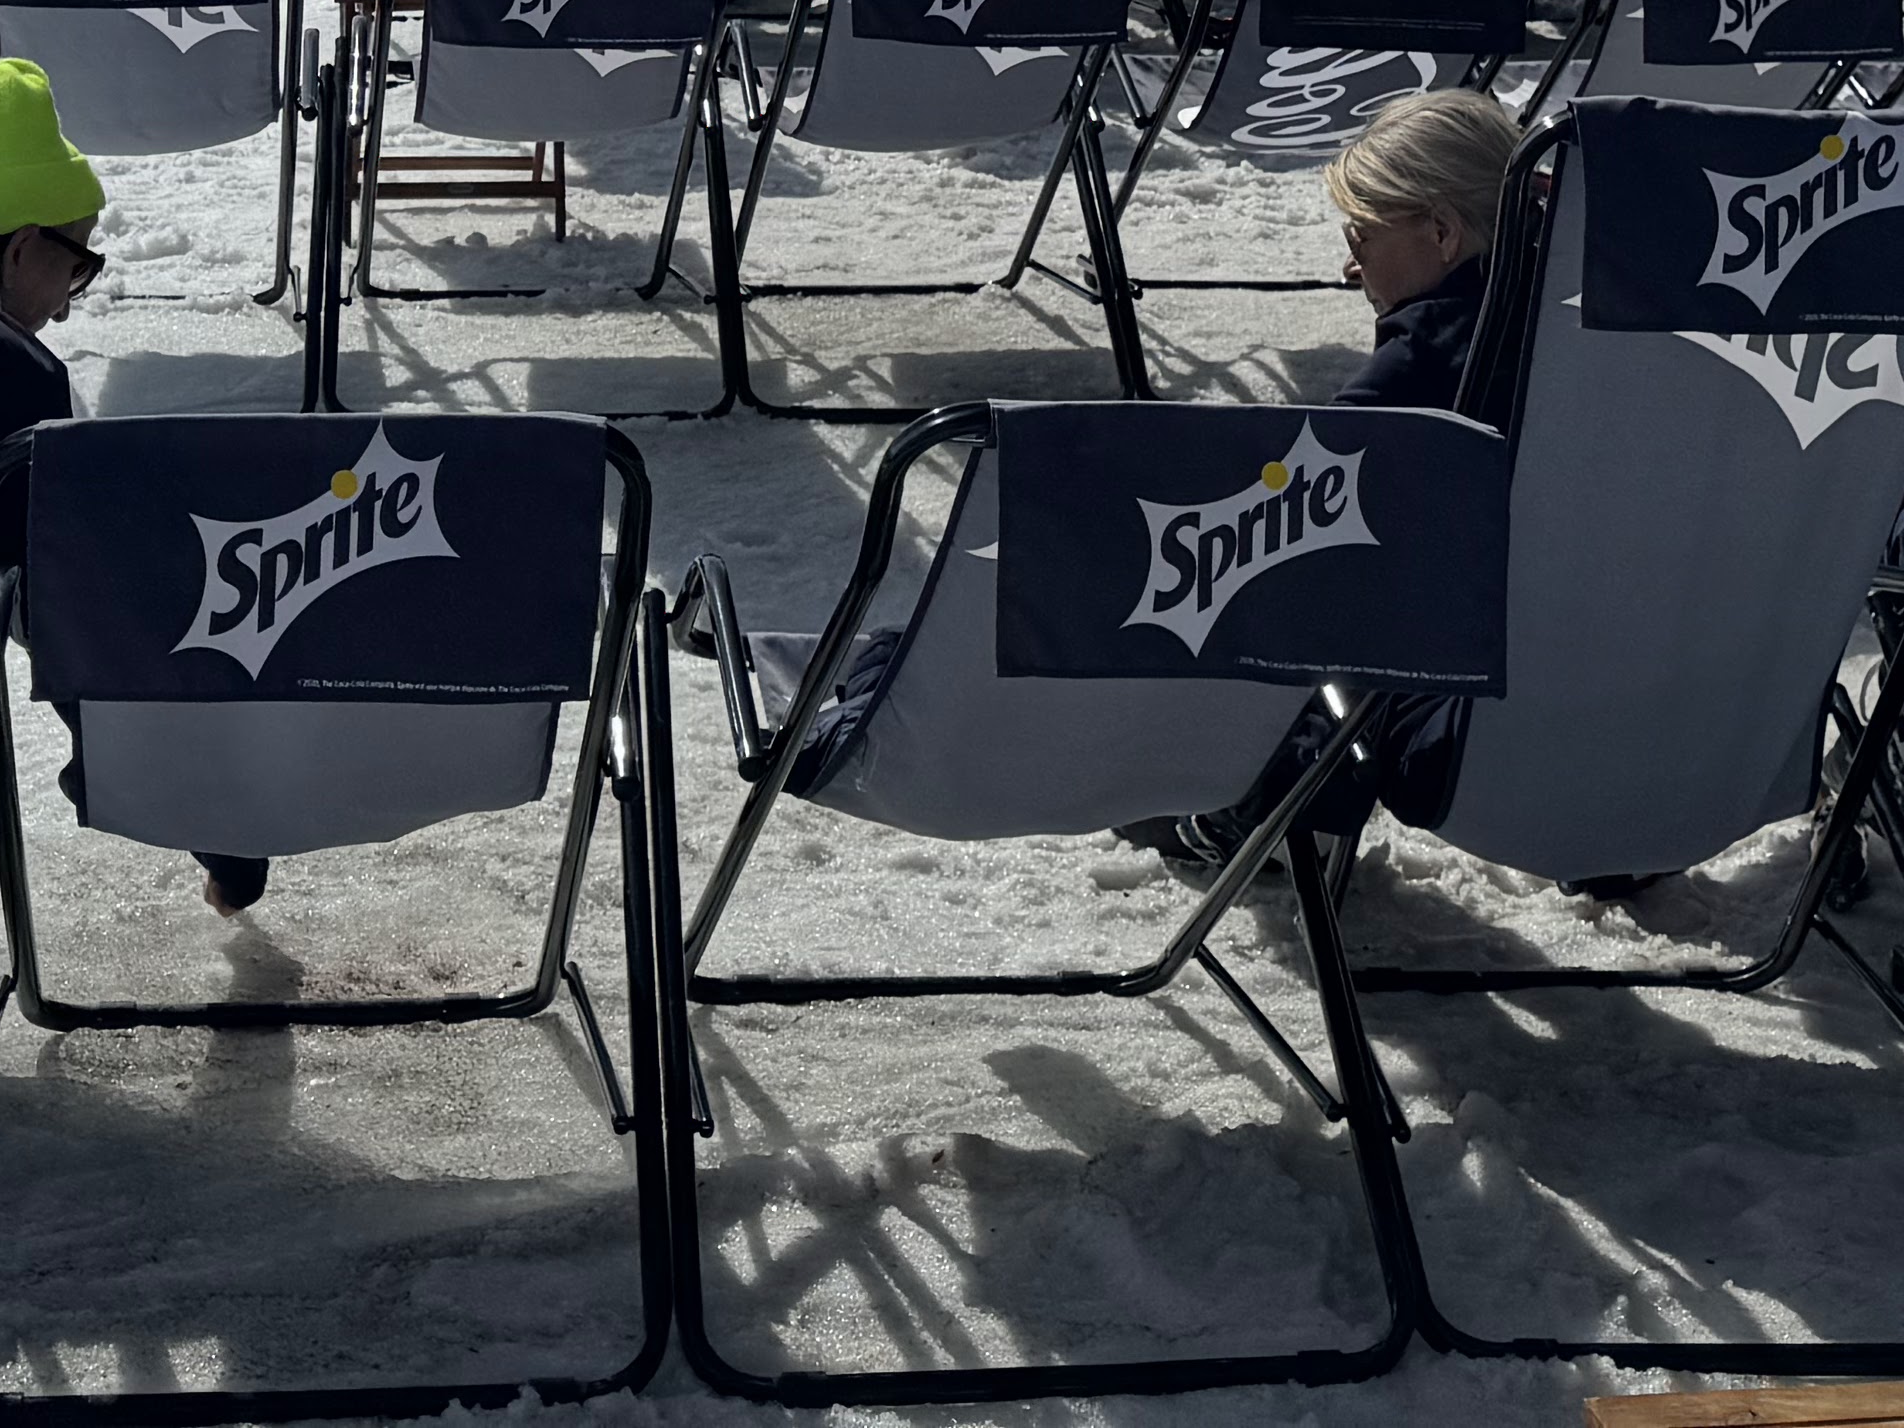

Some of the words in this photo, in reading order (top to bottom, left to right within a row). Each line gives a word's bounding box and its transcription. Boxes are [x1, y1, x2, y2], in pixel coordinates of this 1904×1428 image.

[1721, 133, 1899, 275] Sprite
[208, 469, 424, 637] Sprite
[1152, 461, 1349, 614] Sprite
